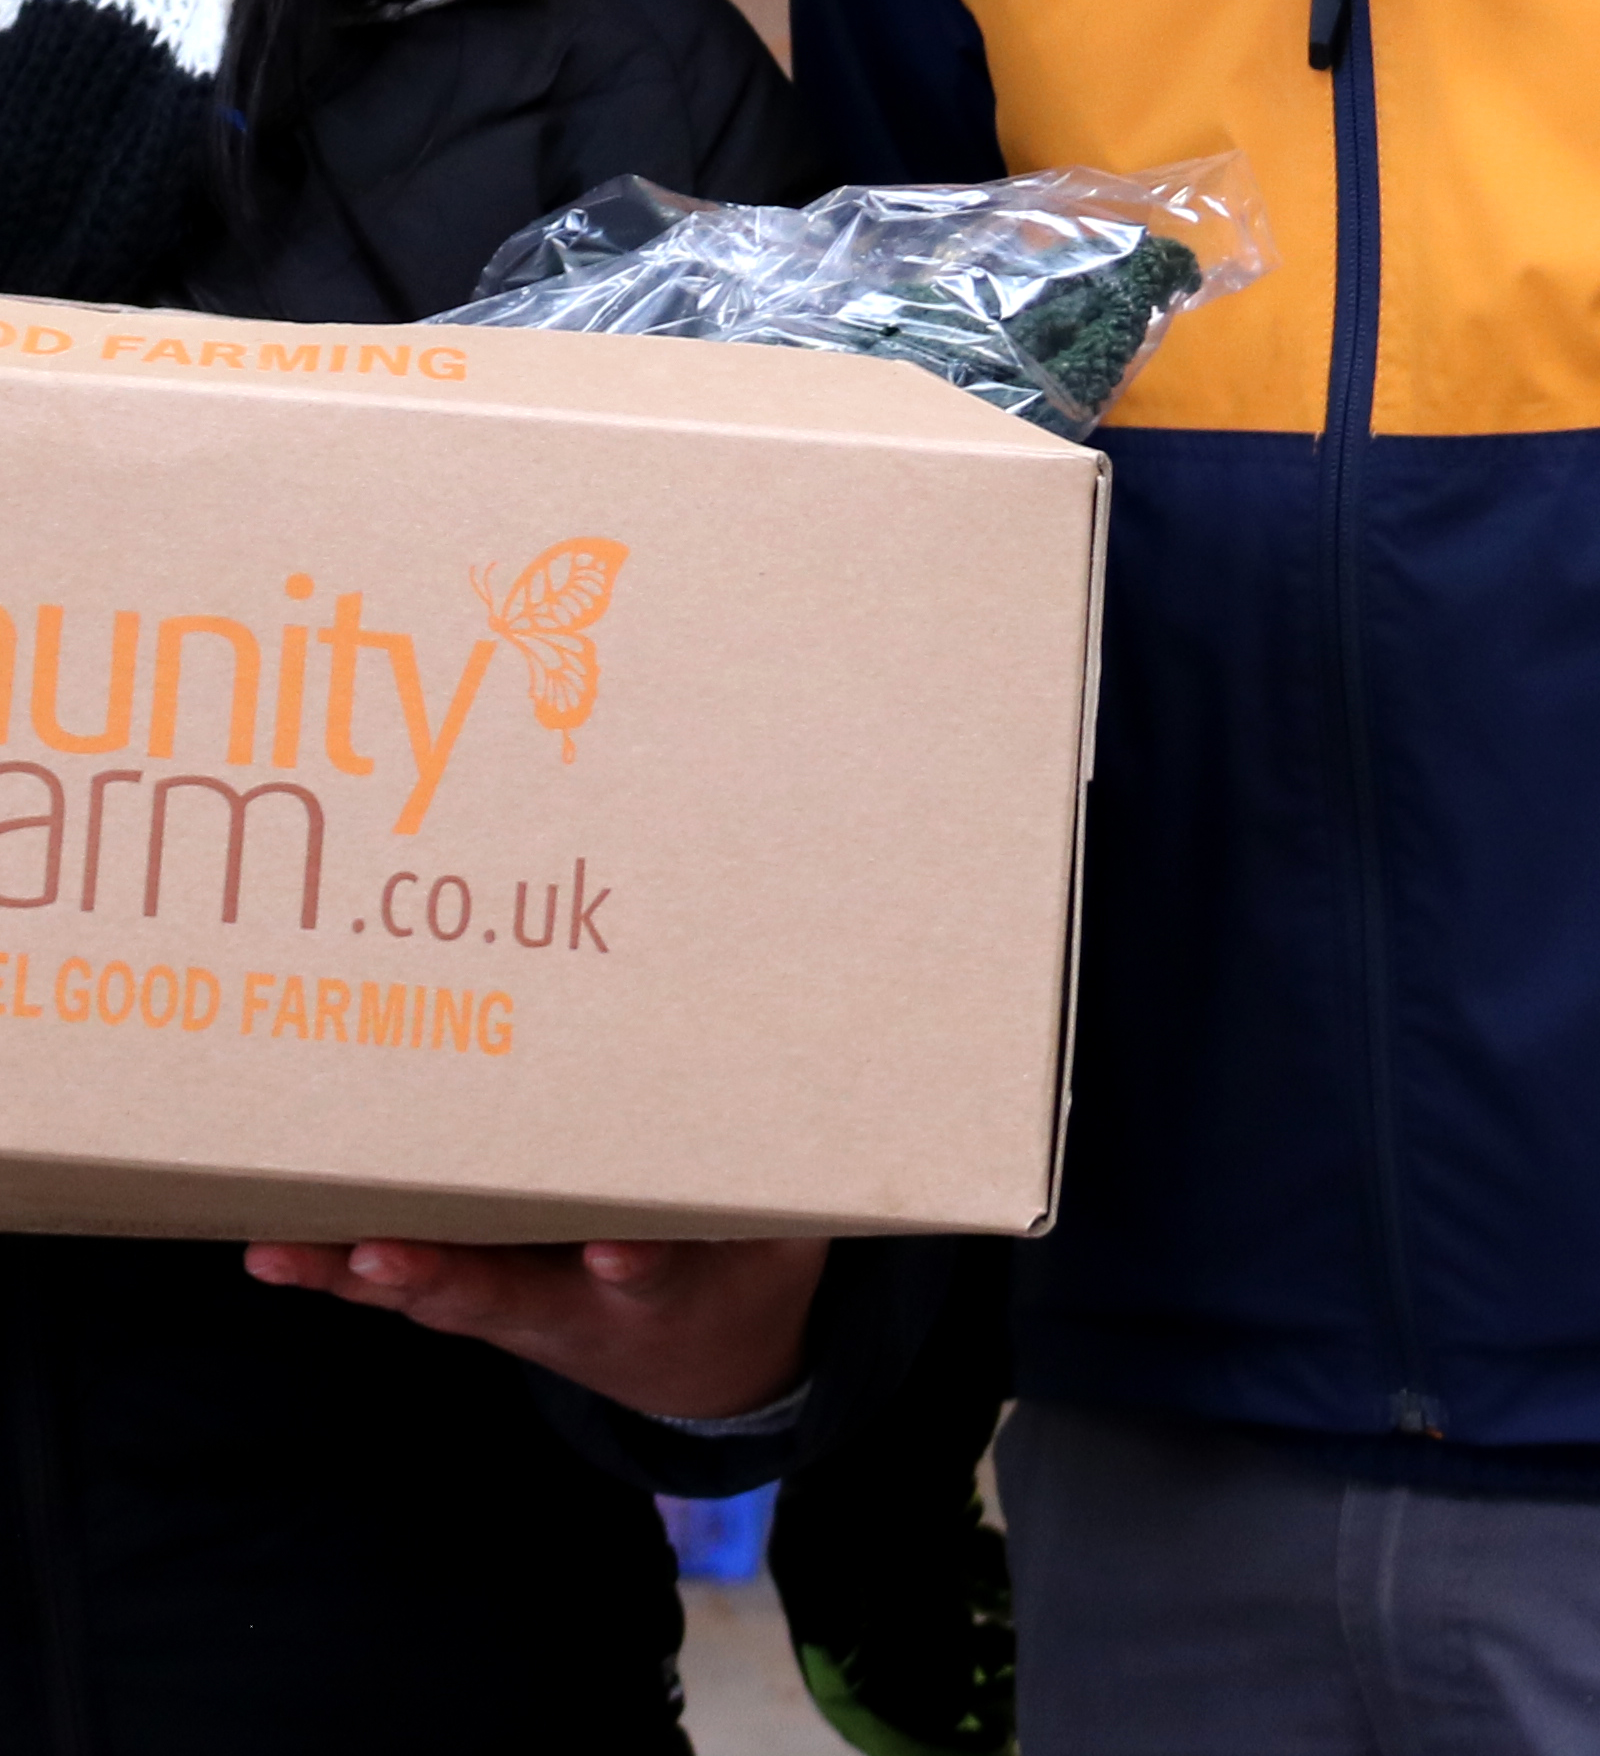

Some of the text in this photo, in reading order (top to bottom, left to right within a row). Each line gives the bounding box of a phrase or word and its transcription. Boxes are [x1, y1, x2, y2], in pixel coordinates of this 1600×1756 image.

[100, 334, 468, 382] FARMING
[53, 957, 222, 1033] GOOD
[240, 971, 515, 1057] FARMING
